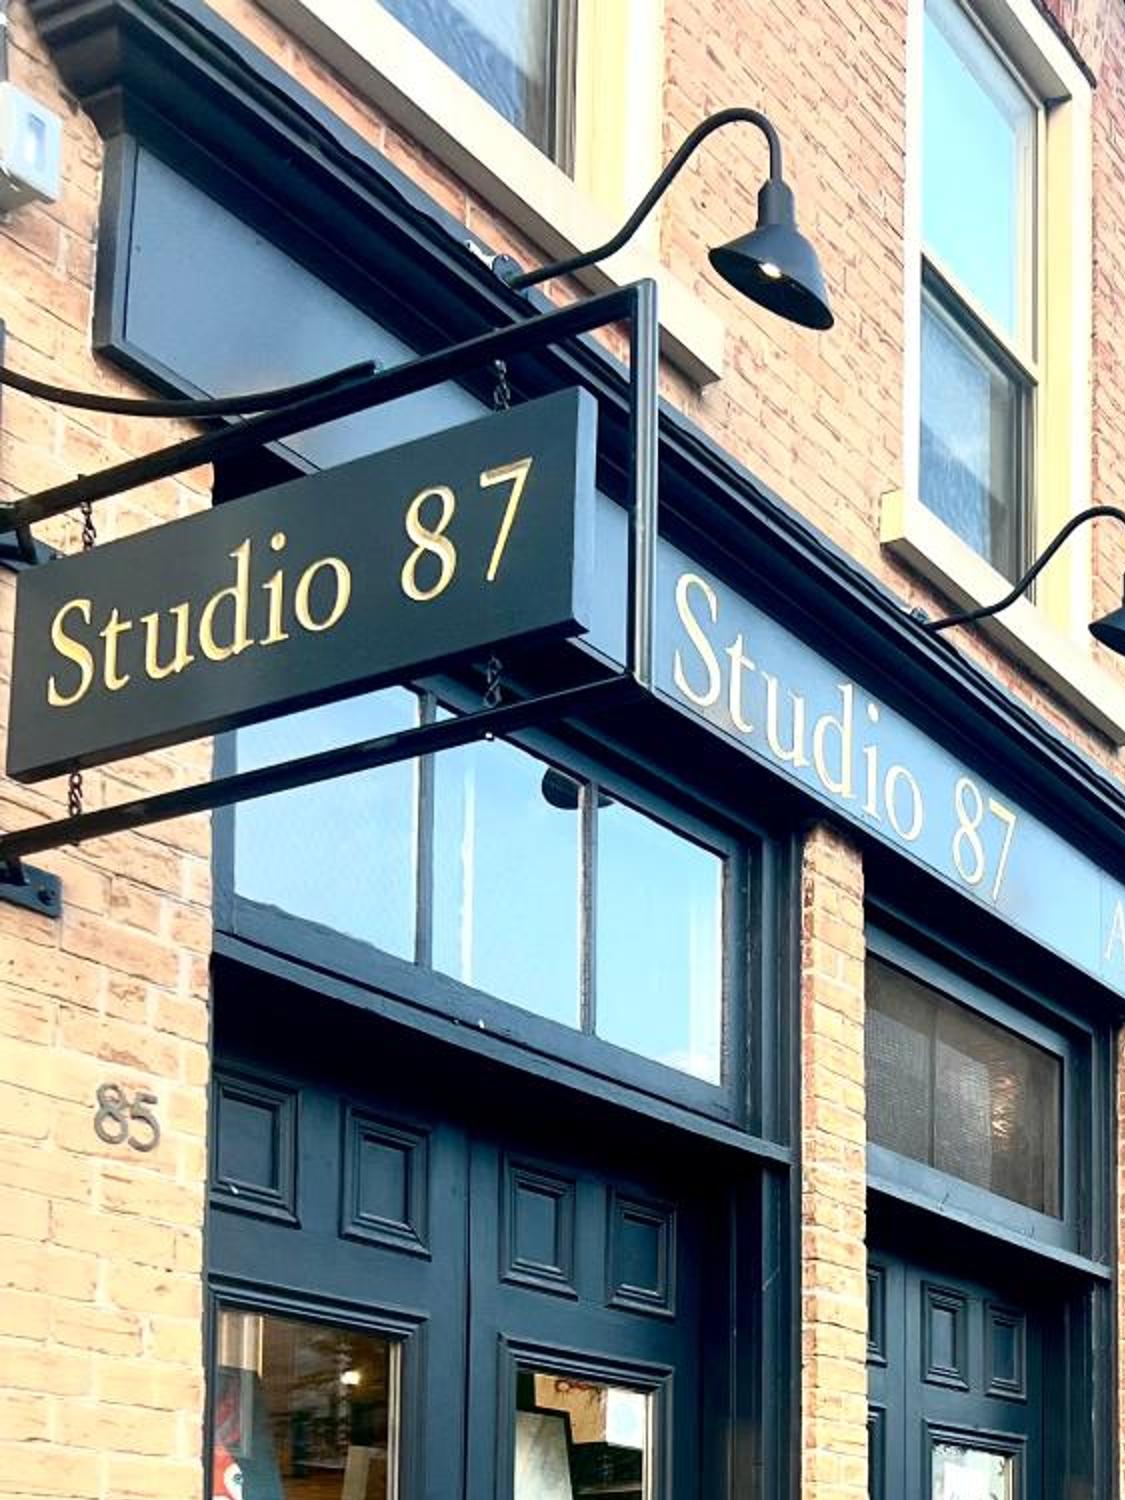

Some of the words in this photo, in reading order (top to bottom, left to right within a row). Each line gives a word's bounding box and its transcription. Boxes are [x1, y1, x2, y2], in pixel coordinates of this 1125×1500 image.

[47, 530, 352, 706] Studio
[400, 457, 533, 601] 87
[673, 572, 923, 840] Studio
[951, 778, 1017, 900] 87
[94, 1083, 160, 1152] 85
